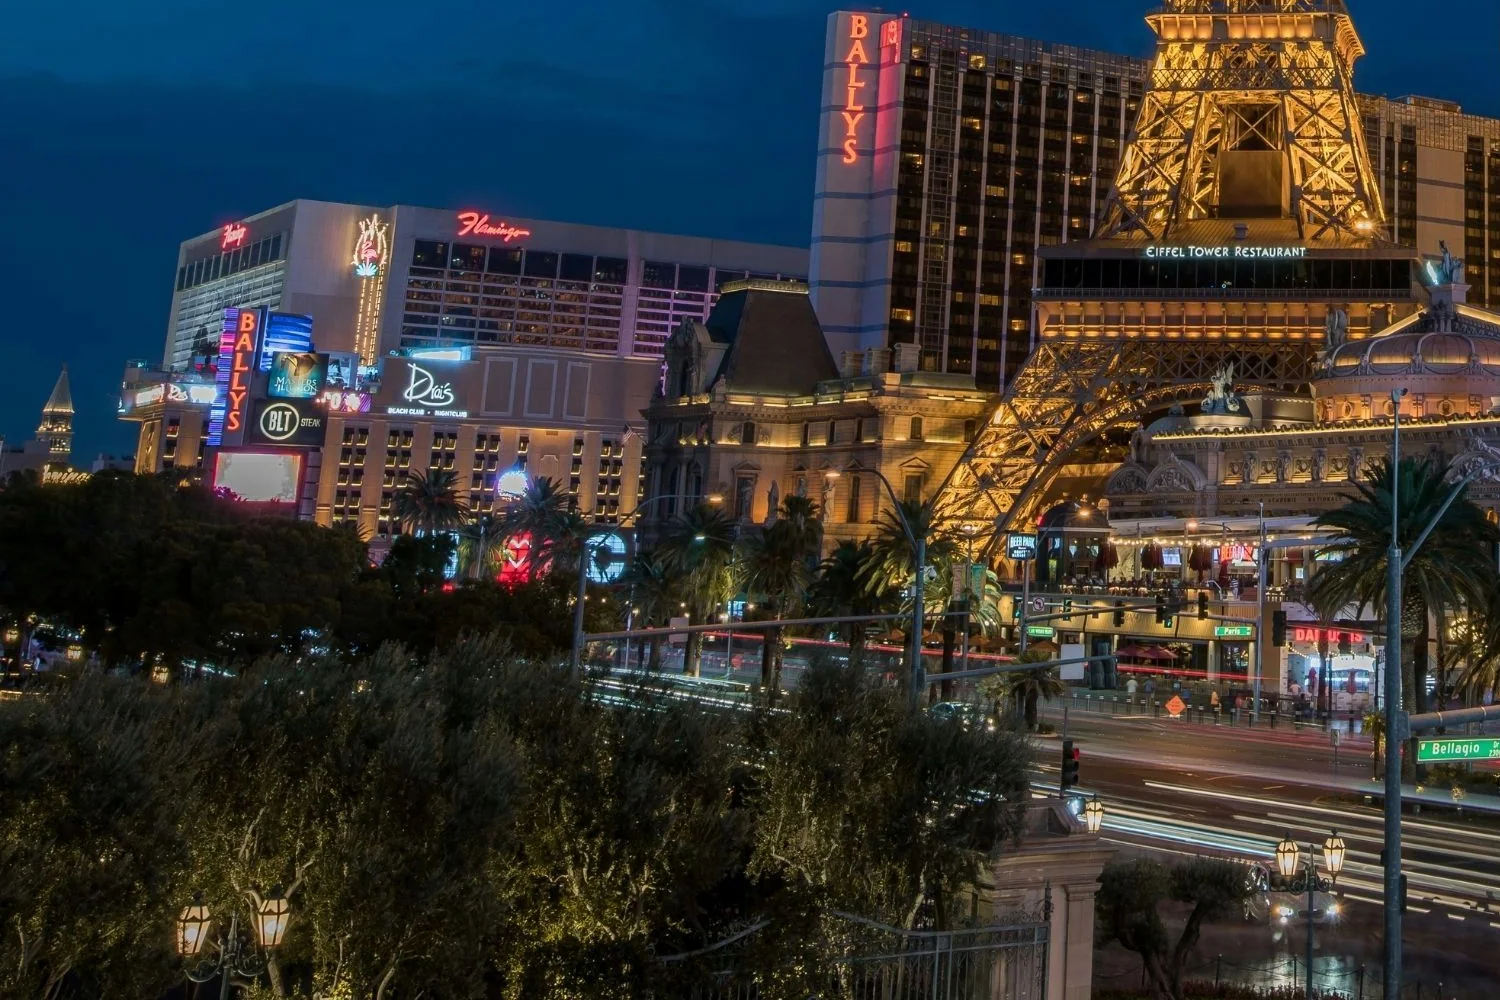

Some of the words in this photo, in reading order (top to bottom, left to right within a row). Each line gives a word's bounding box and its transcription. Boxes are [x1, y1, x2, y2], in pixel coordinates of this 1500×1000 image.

[458, 212, 530, 242] Flamingo
[1146, 246, 1185, 257] EIFFEL
[1188, 246, 1229, 257] TOWER
[1235, 246, 1306, 257] RESTAURANT
[404, 363, 455, 406] Drai's
[268, 411, 292, 431] BLT
[301, 418, 321, 427] STEAK
[1295, 627, 1363, 642] DAIUIS
[1432, 742, 1480, 756] Bellagio
